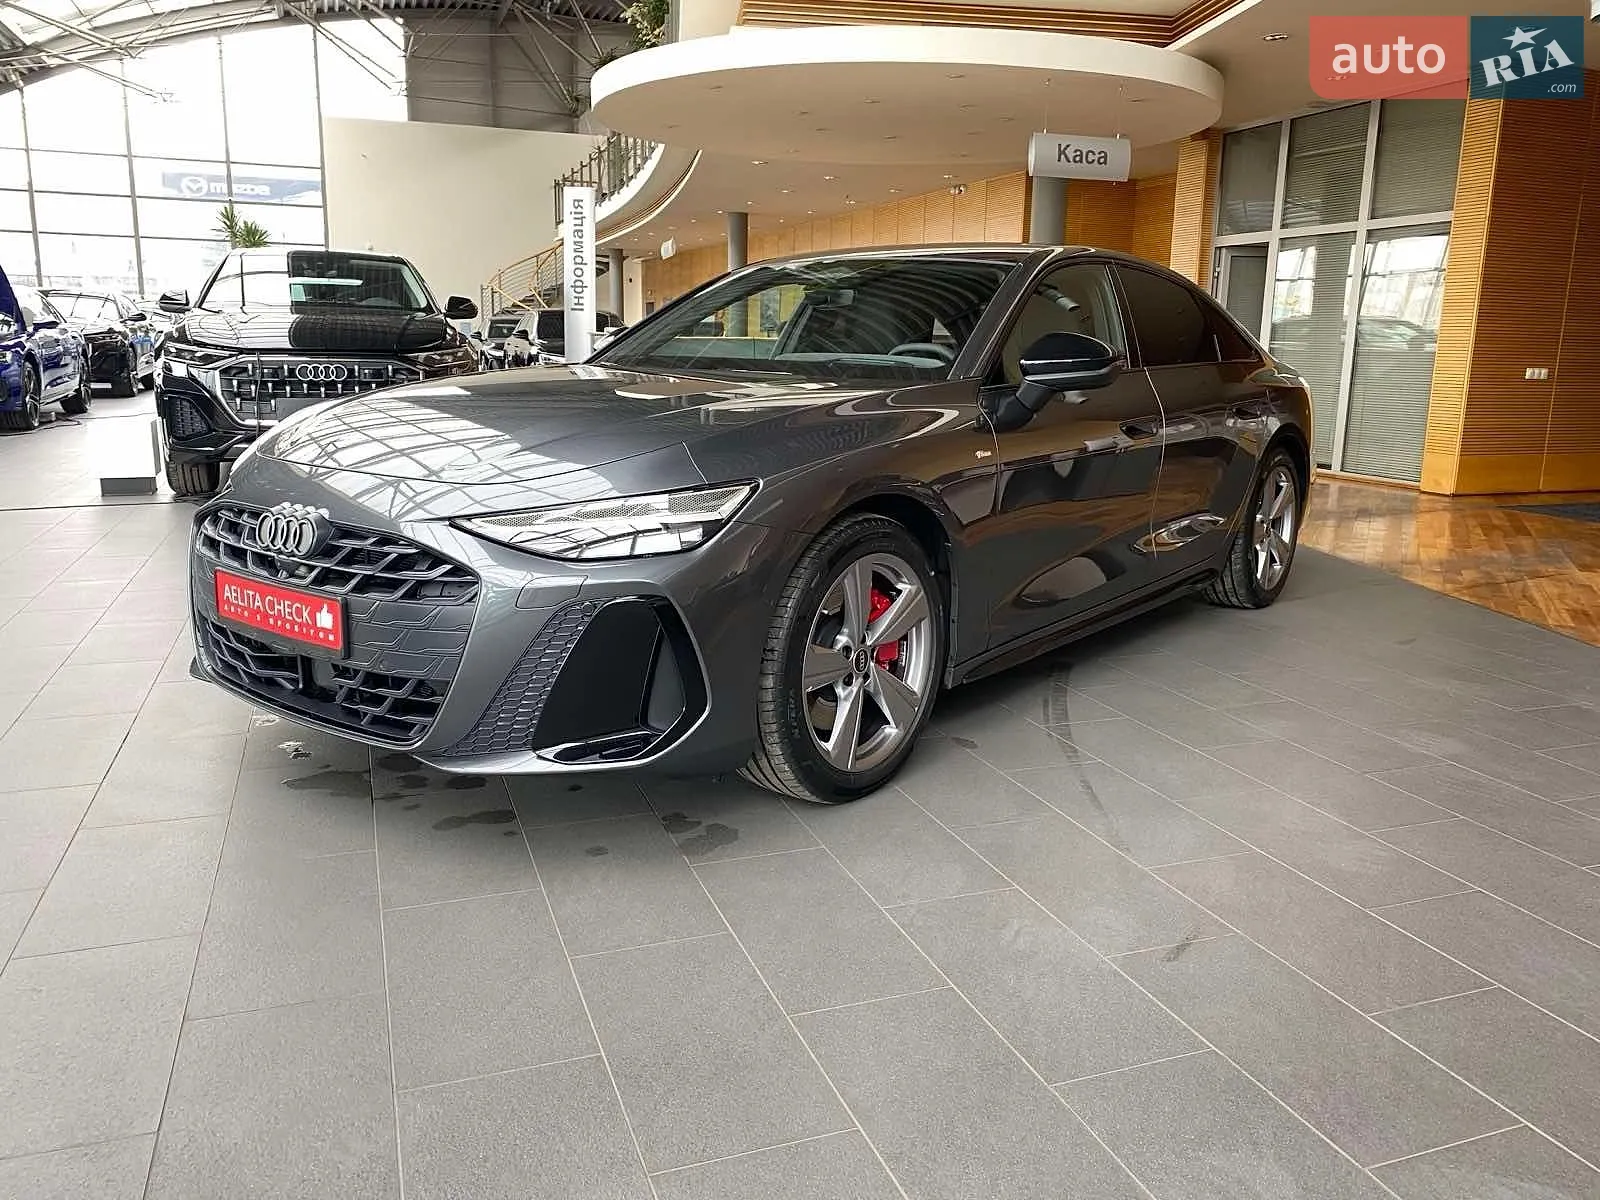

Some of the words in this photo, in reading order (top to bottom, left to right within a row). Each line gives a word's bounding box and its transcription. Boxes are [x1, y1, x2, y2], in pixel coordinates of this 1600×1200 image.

[1057, 143, 1108, 165] Каса
[570, 198, 588, 312] Інформація
[224, 583, 264, 612] AELITA
[265, 595, 313, 625] CHECK
